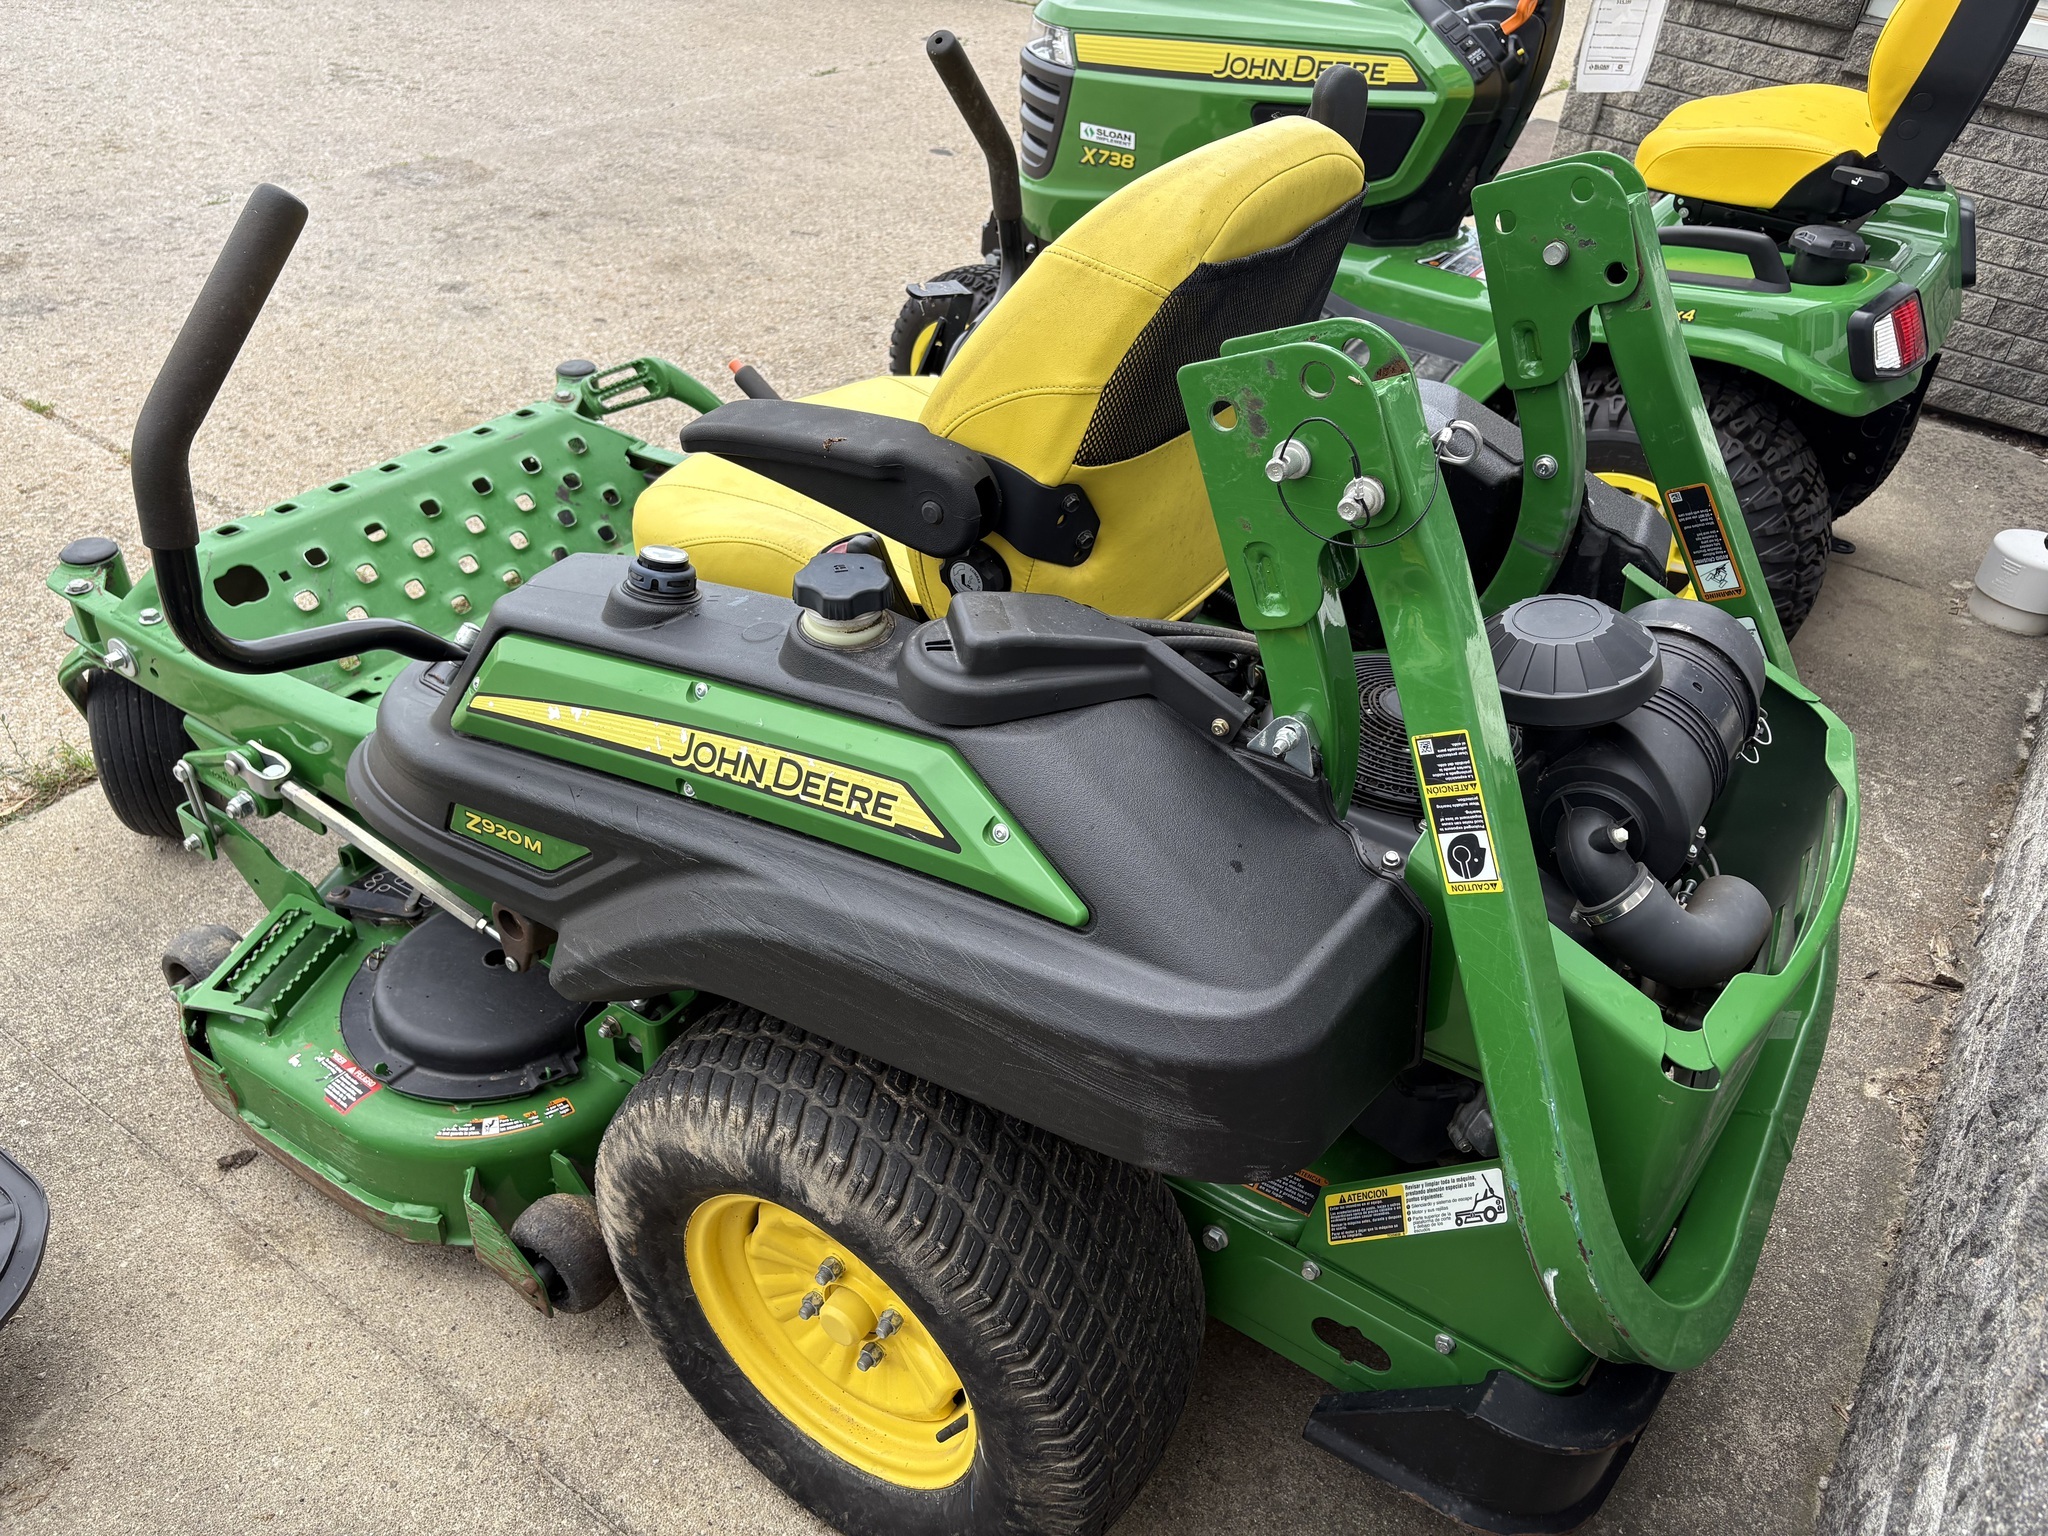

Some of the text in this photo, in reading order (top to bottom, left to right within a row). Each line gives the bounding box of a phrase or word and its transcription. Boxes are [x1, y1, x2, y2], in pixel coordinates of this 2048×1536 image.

[1213, 52, 1288, 78] JOHN
[1096, 136, 1132, 147] IMPLEMENT
[1097, 128, 1132, 142] SLOAN
[1081, 146, 1135, 169] X738
[1705, 590, 1735, 600] WARNING
[673, 733, 898, 822] JOHN DEERE
[1426, 784, 1468, 795] ATENCIÓN
[465, 811, 542, 854] Z920M
[1451, 883, 1490, 892] CAUTION
[354, 1070, 376, 1087] PELIGRO
[1347, 1189, 1387, 1202] ATENCION
[1405, 1189, 1425, 1197] prestando
